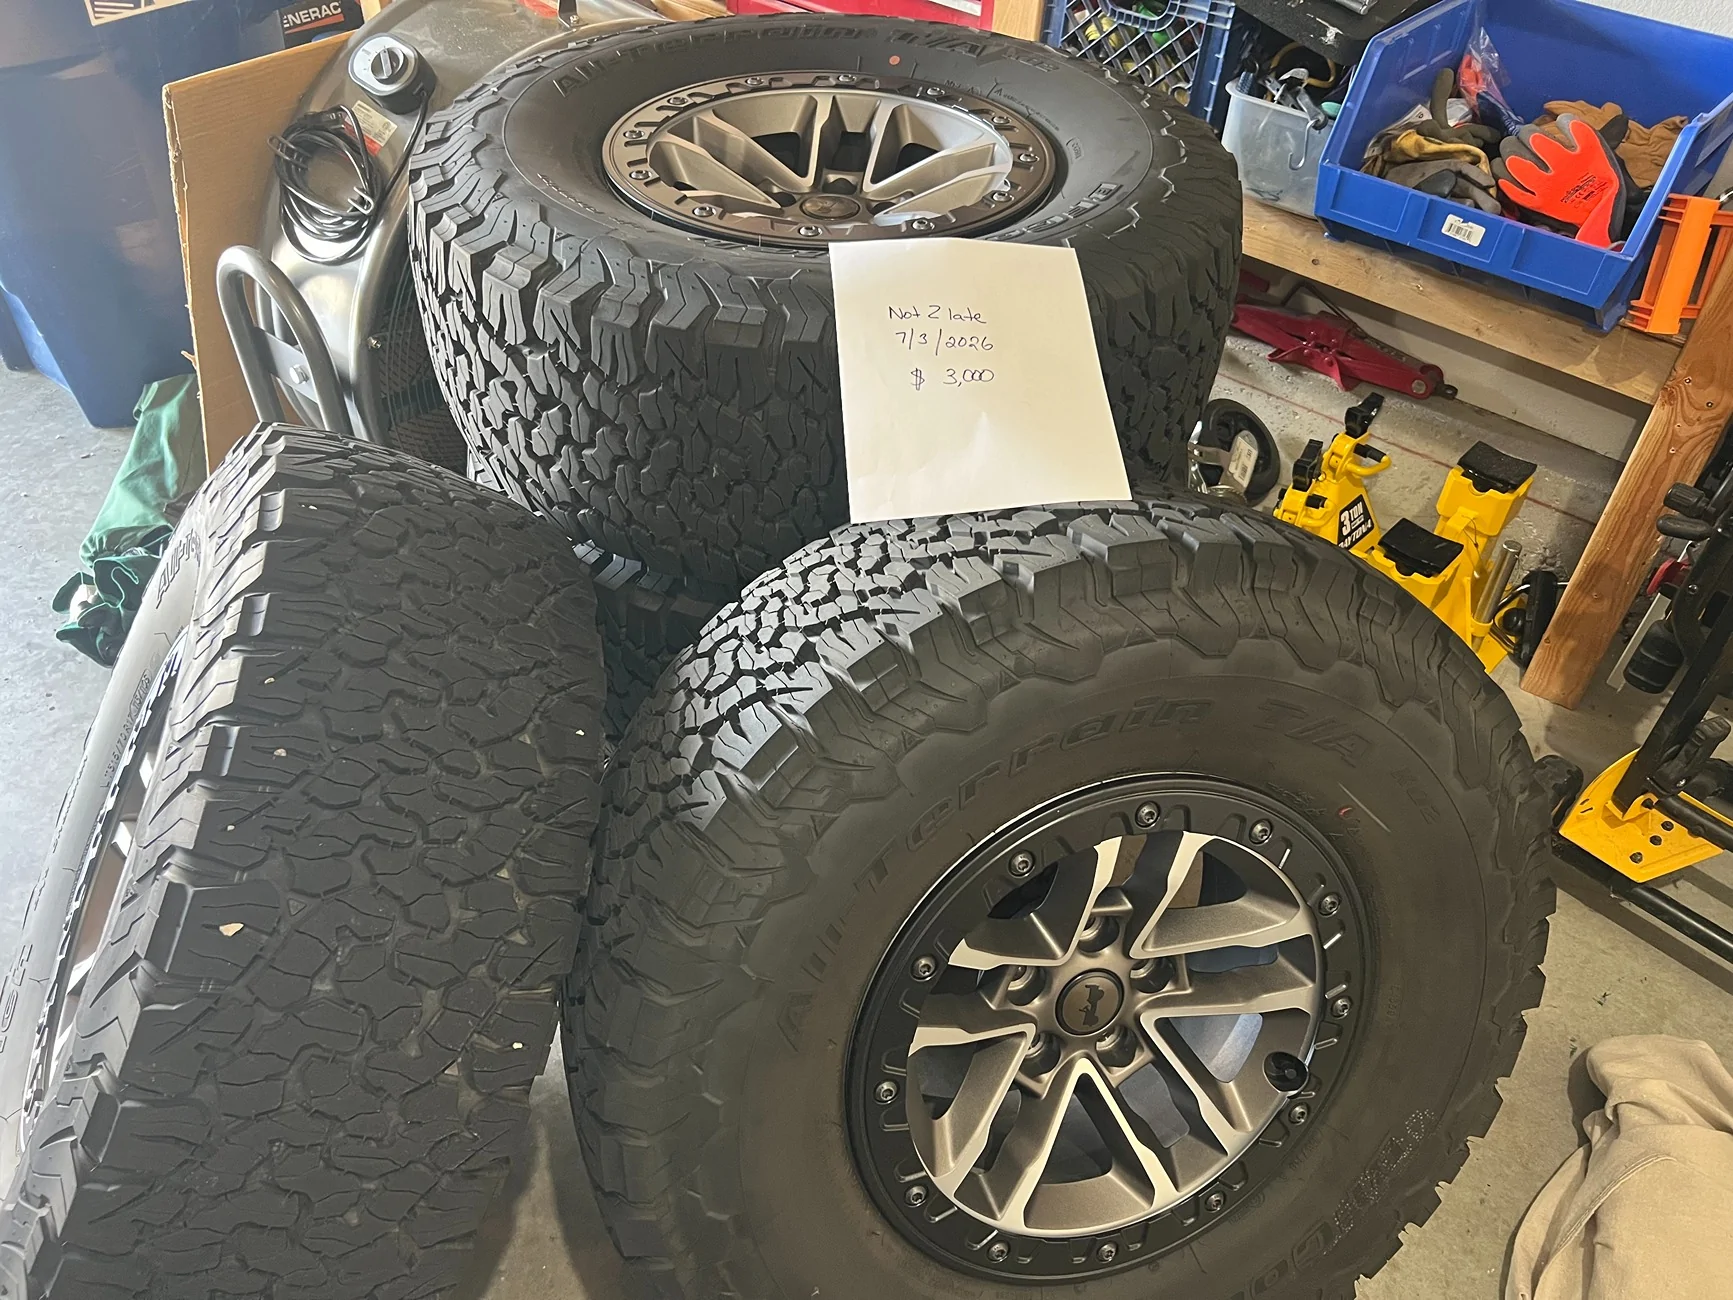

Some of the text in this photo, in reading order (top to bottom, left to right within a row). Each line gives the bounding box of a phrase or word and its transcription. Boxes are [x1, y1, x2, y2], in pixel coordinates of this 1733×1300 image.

[282, 1, 342, 28] ENERAC
[888, 305, 921, 320] Not
[948, 306, 987, 324] late
[895, 327, 994, 356] 7/3/2026
[942, 368, 995, 388] 3,000
[1340, 510, 1351, 536] 3
[1349, 501, 1364, 521] TON
